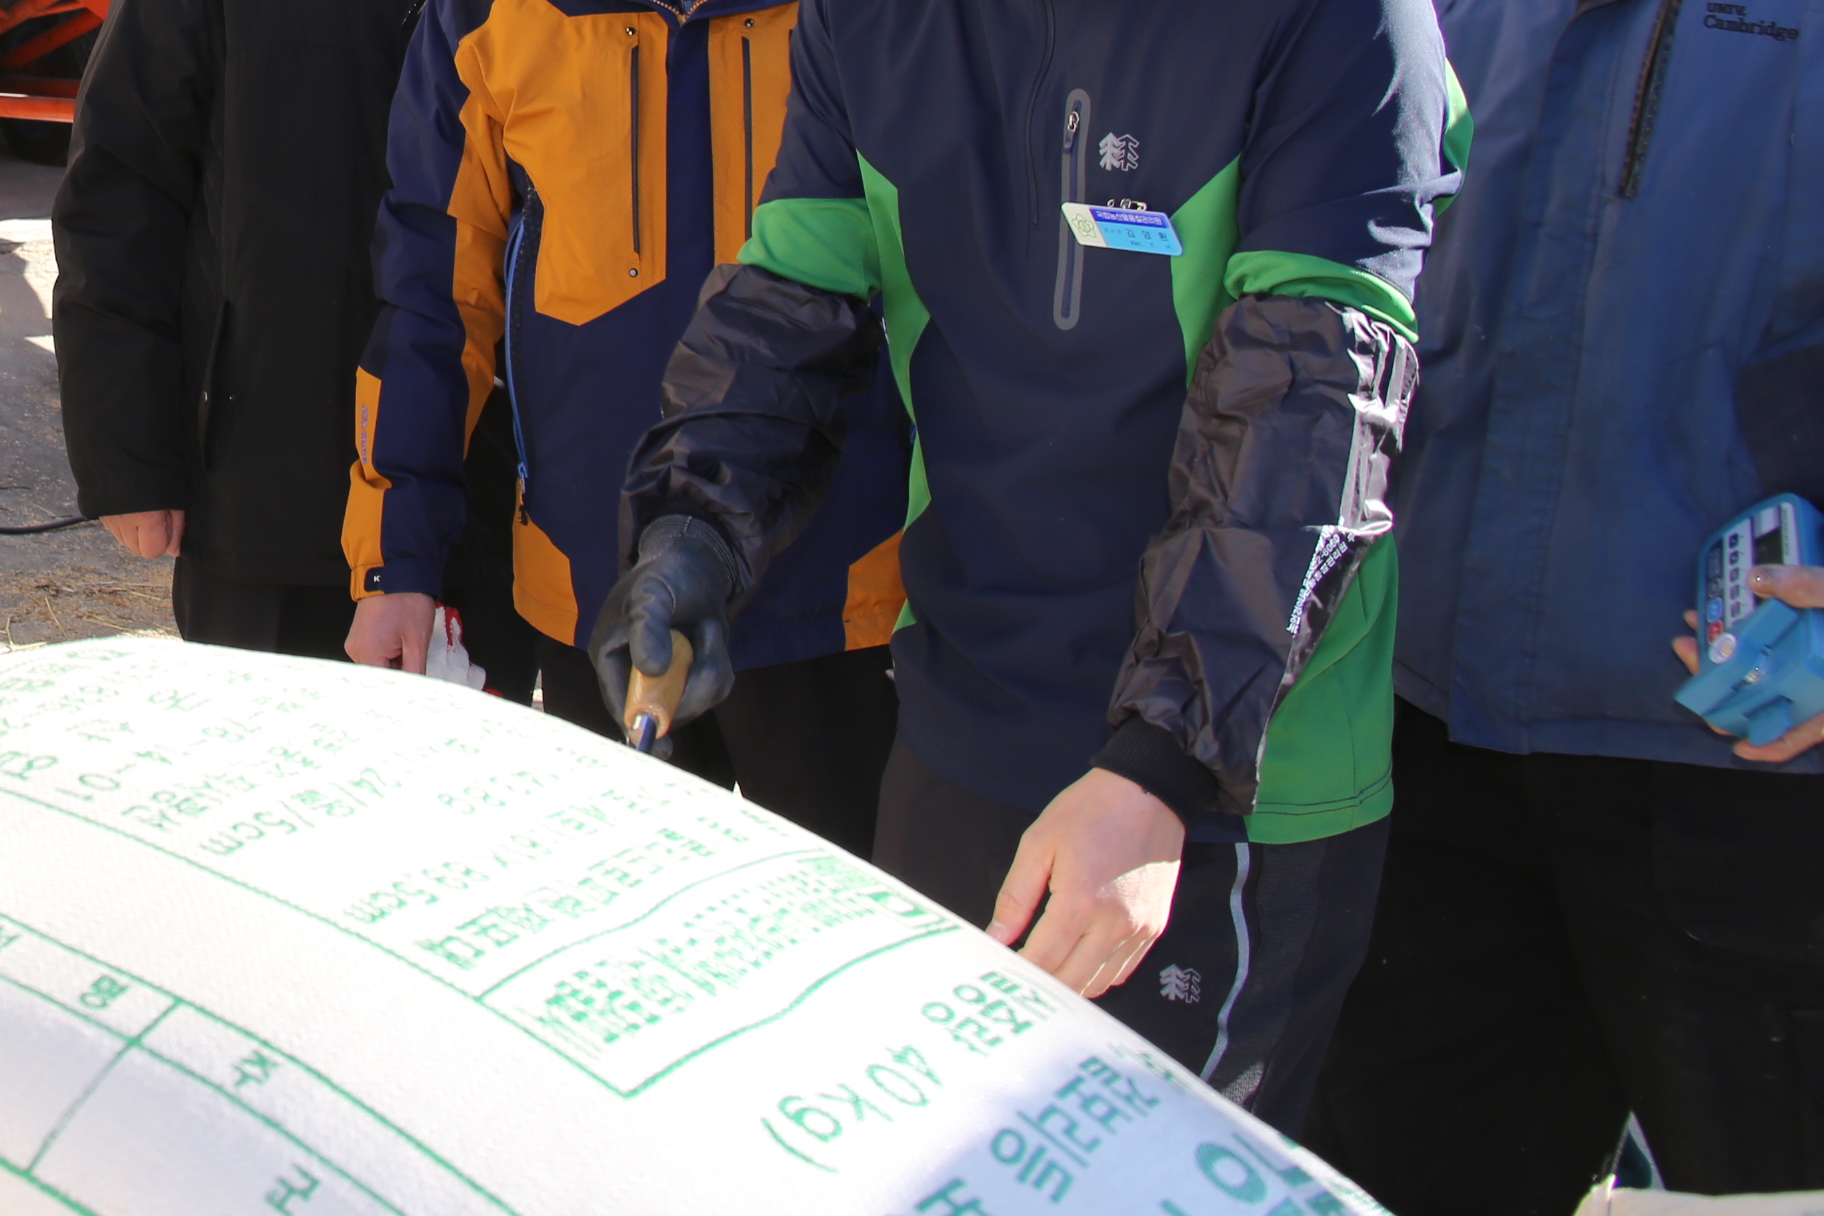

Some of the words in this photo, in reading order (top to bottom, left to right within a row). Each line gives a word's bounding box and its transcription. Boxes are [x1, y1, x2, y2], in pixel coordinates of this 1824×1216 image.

[1703, 14, 1800, 41] Cambridge
[232, 1050, 280, 1088] 주
[761, 1044, 944, 1174] 40kg)
